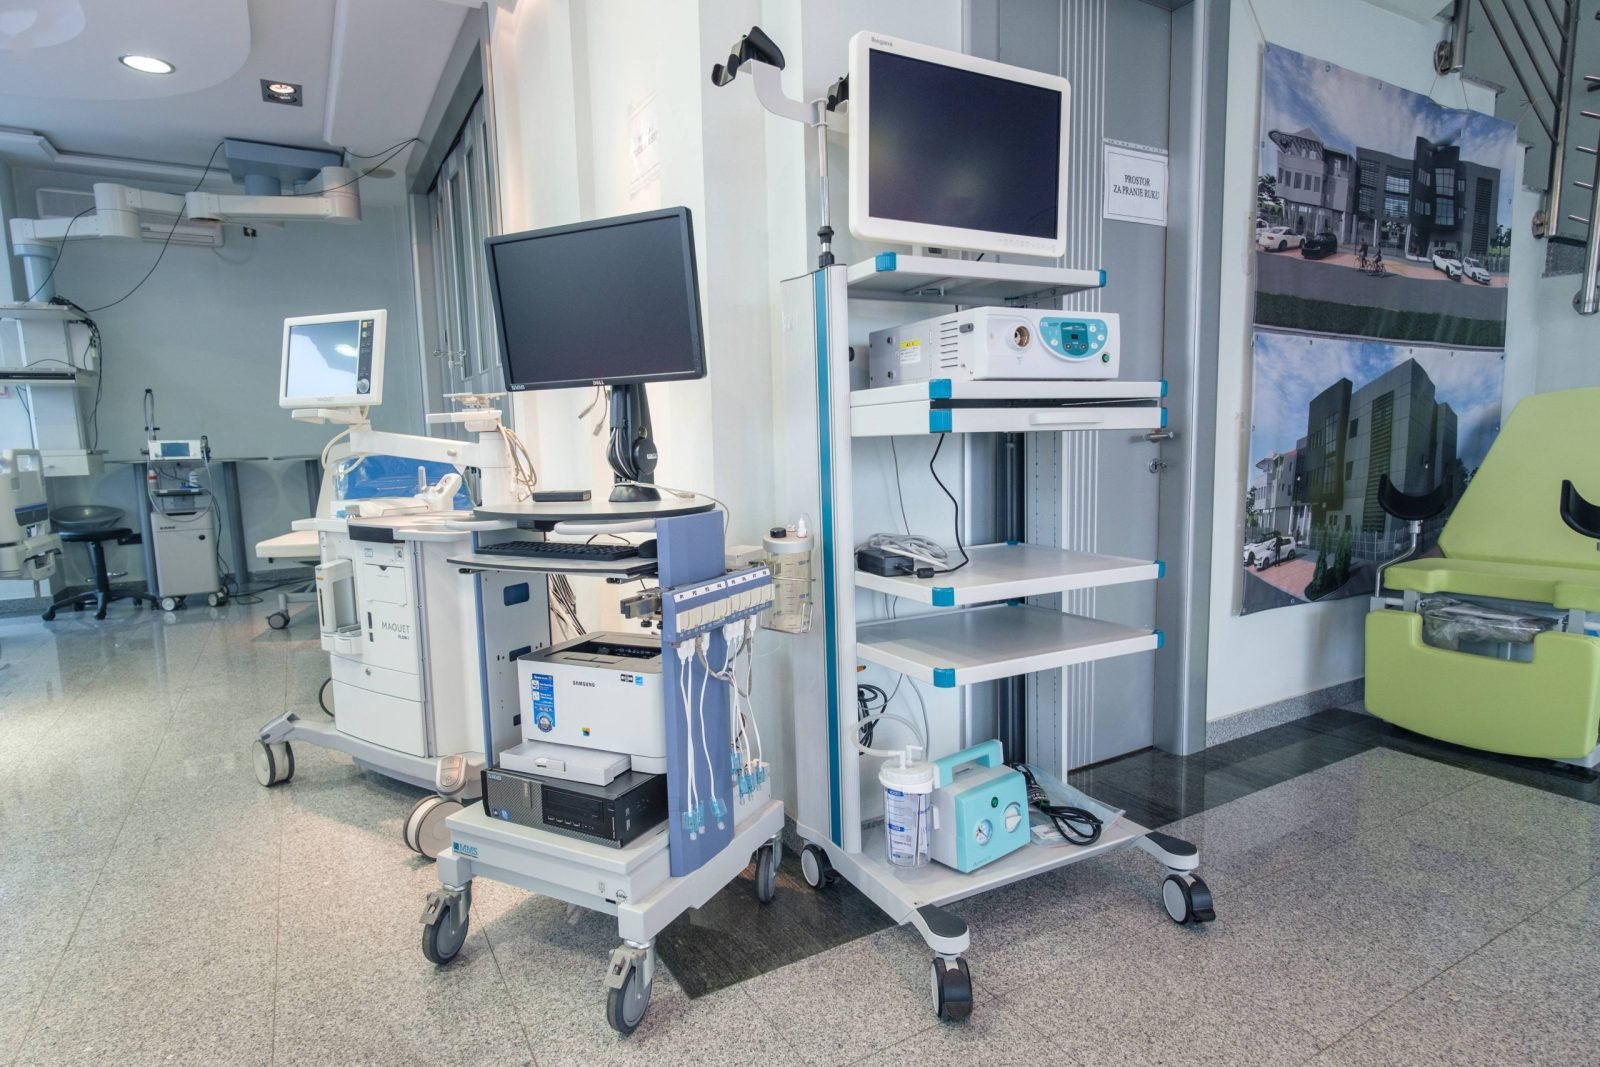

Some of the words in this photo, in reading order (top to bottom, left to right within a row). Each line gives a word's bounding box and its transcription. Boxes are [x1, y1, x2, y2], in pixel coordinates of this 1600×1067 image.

[1124, 174, 1151, 186] PROSTOR
[1113, 184, 1121, 194] ZA
[1122, 185, 1144, 197] PRANJE
[1144, 189, 1160, 200] RUKU
[381, 621, 411, 633] MAQUET
